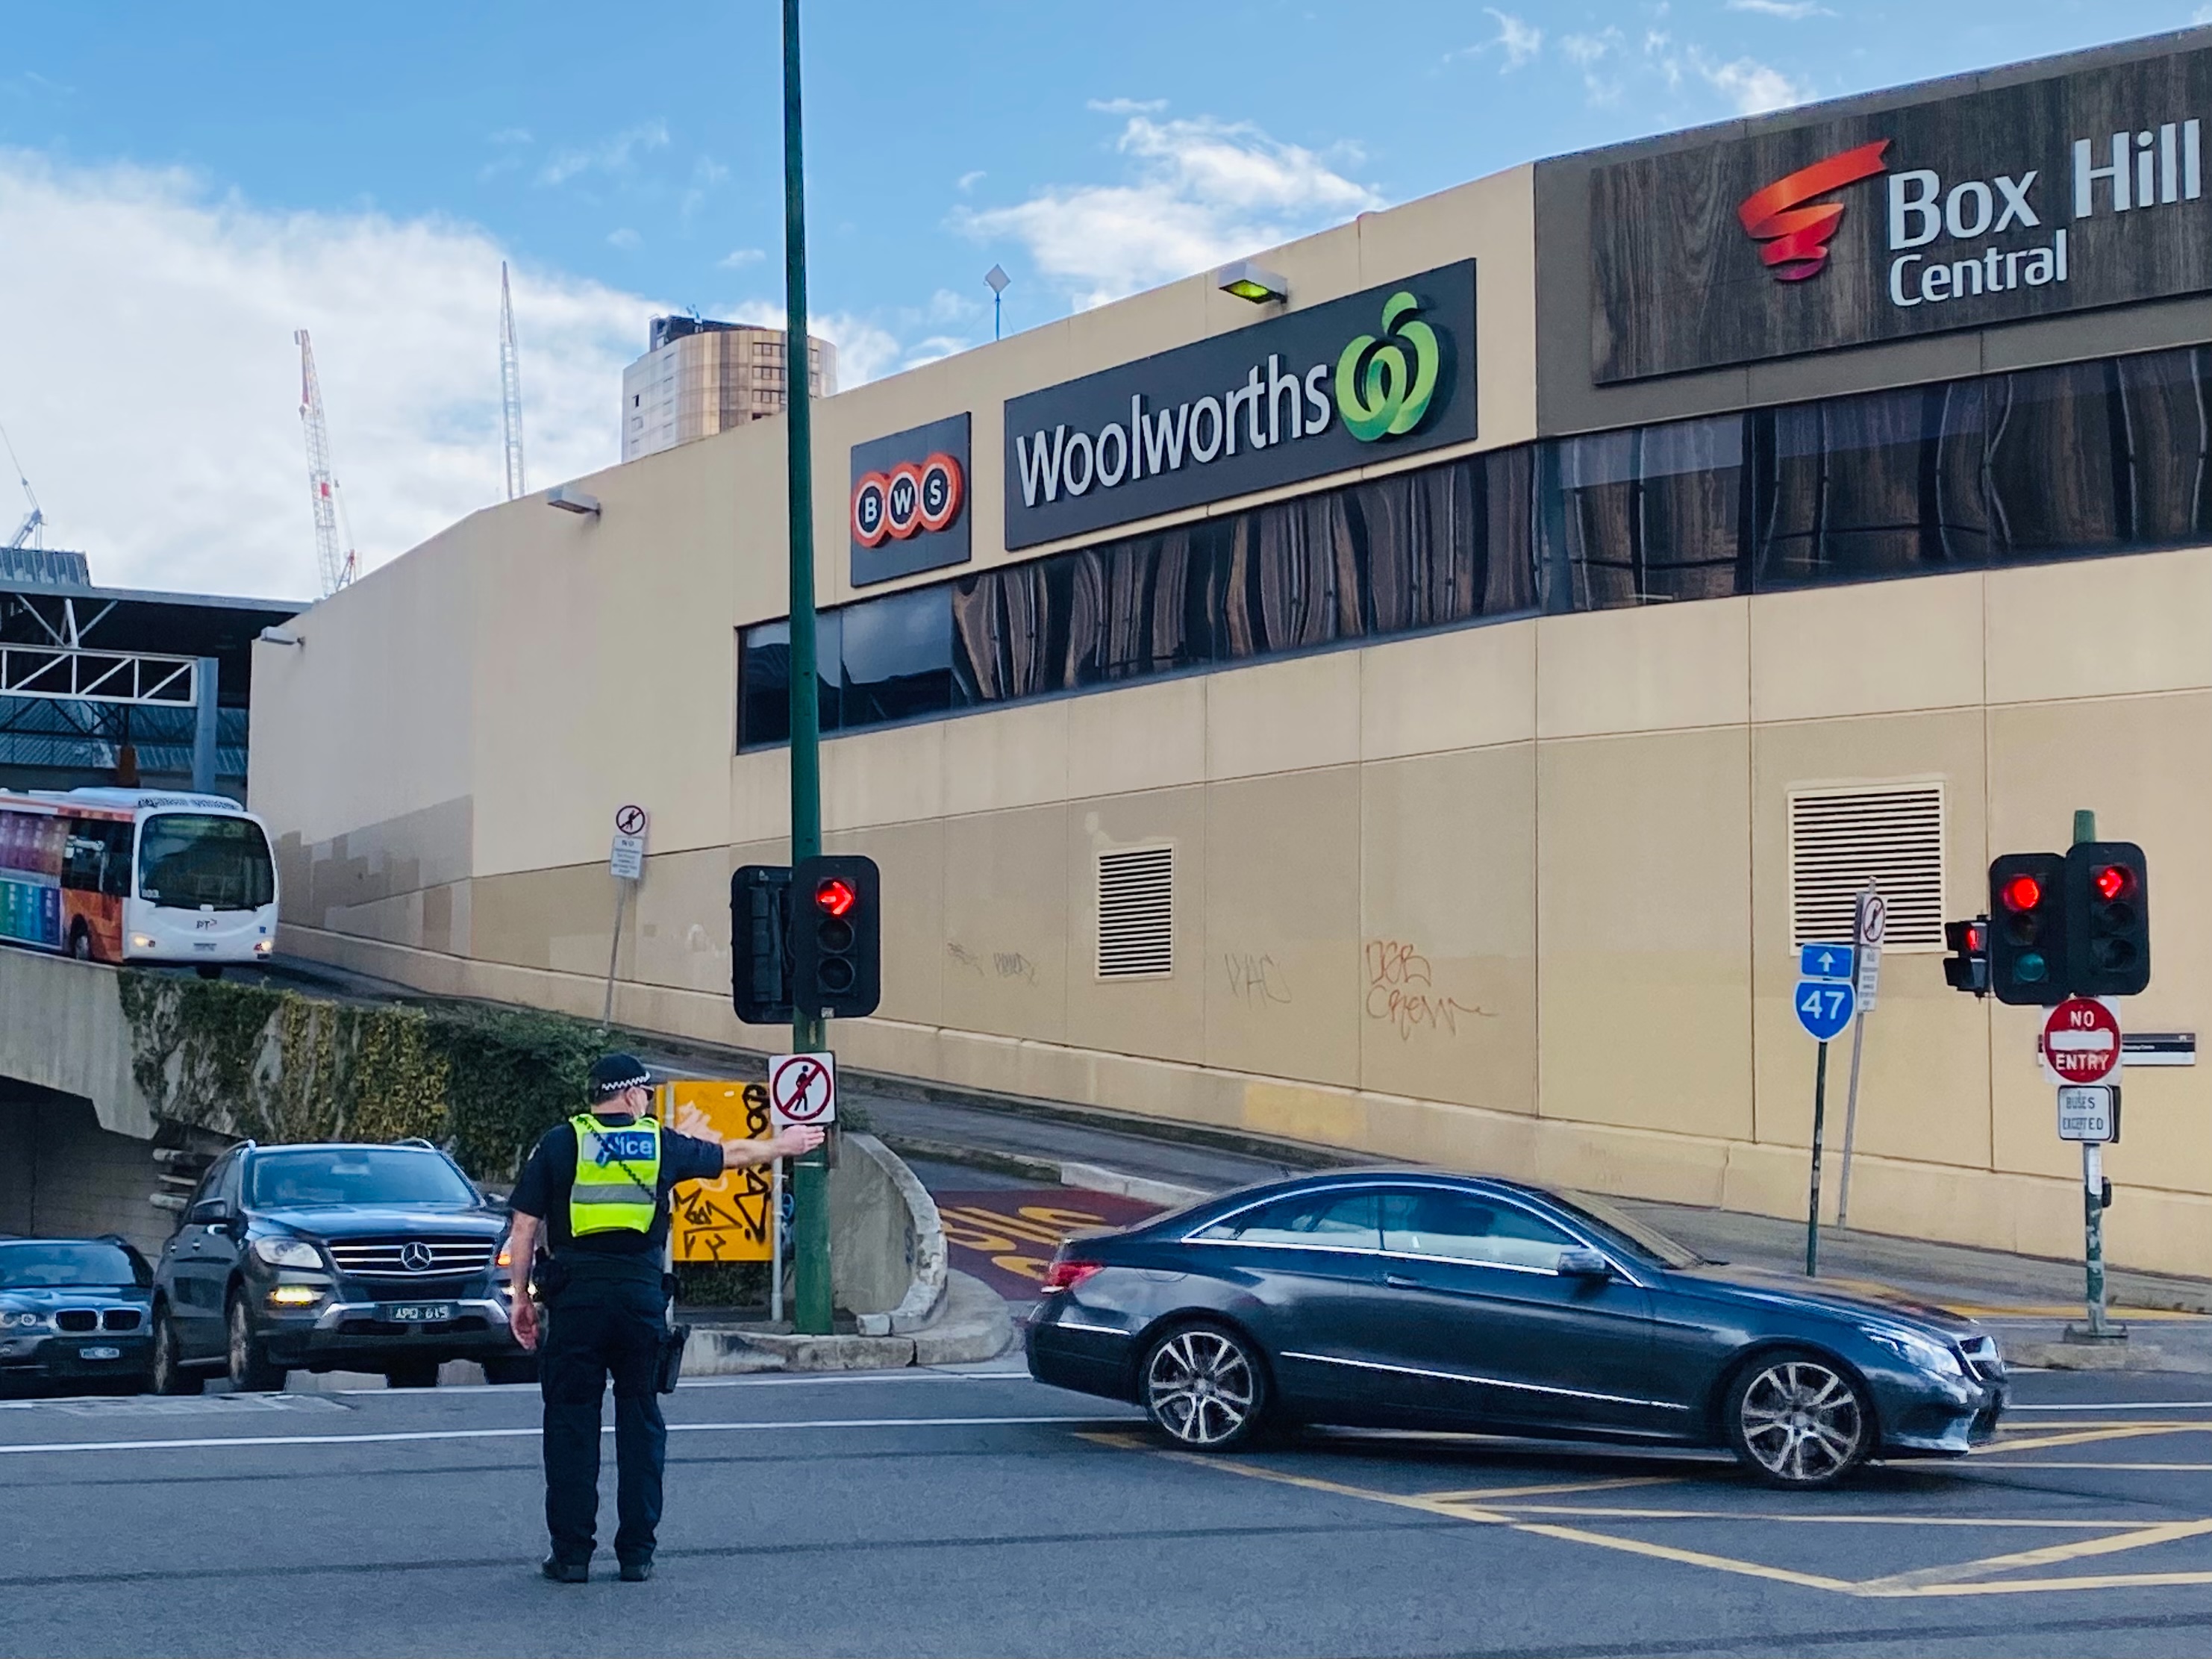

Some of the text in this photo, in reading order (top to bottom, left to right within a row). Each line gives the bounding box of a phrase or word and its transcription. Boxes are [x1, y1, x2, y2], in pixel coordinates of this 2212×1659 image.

[1888, 118, 2202, 251] Box Hill
[1890, 228, 2069, 307] Central
[1016, 353, 1332, 508] Woolworths
[863, 478, 946, 524] BWS
[1801, 990, 1845, 1019] 47
[2069, 1010, 2096, 1028] NO
[2055, 1053, 2110, 1071] ENTRY
[2066, 1096, 2096, 1110] BUSES
